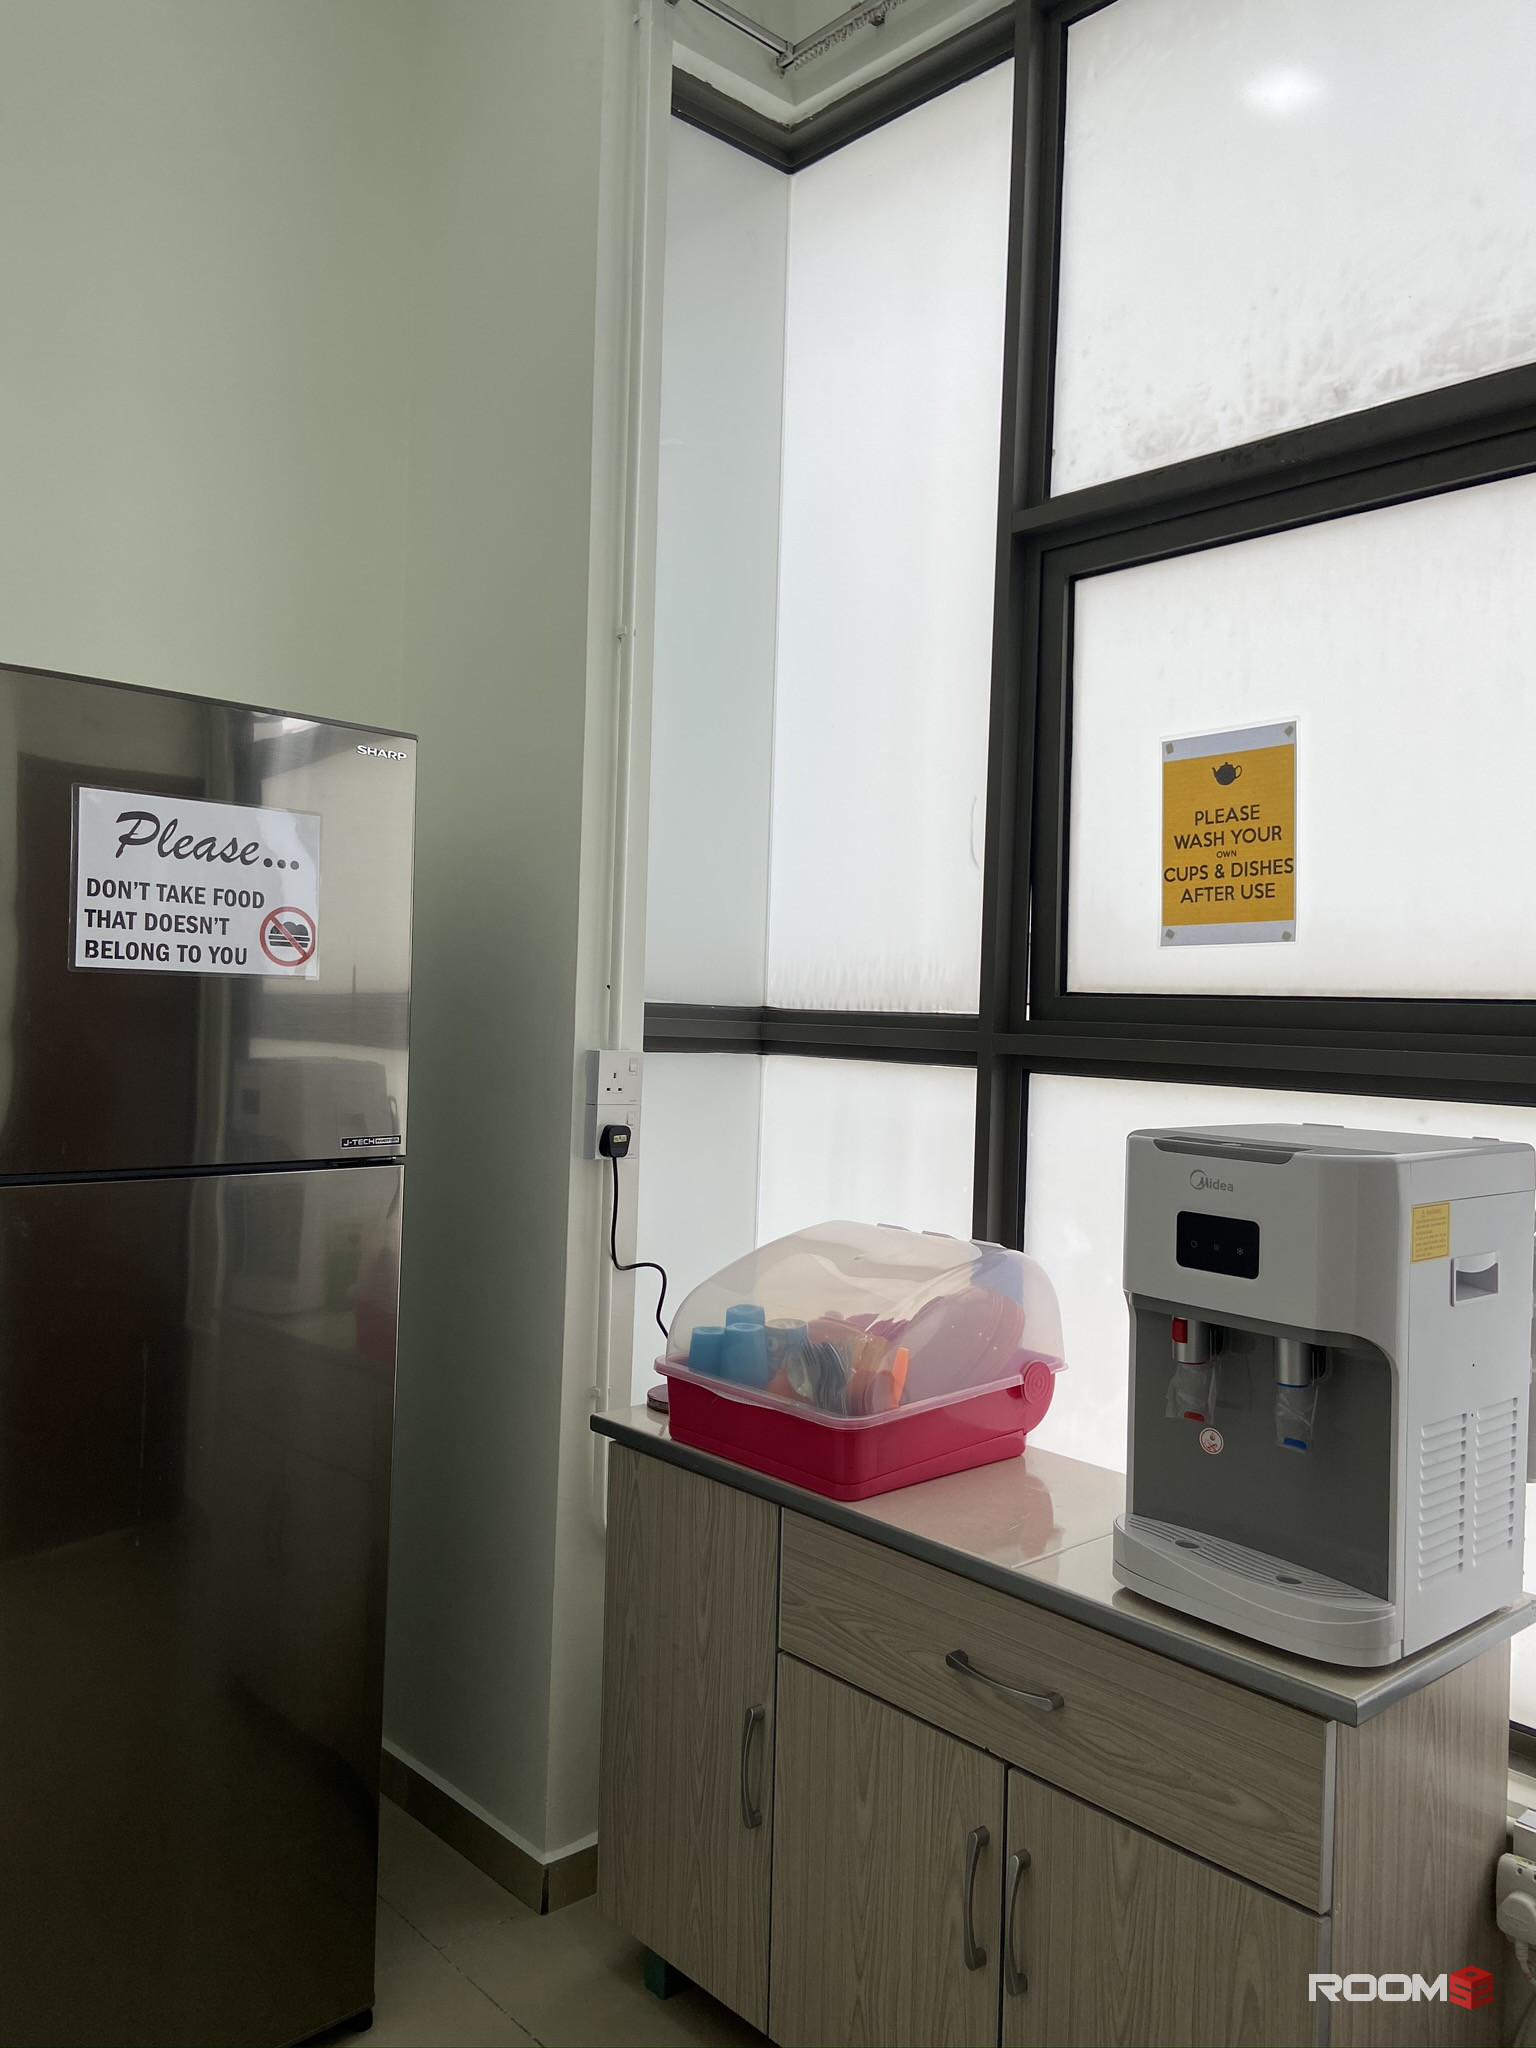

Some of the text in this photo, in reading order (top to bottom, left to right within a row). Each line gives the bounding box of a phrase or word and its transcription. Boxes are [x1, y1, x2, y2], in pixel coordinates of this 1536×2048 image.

[357, 745, 407, 760] SHARP
[1195, 804, 1260, 826] PLEASE
[1174, 826, 1282, 850] WASH YOUR
[1216, 850, 1237, 858] OWN
[1164, 857, 1294, 882] CUPS & DISHES
[86, 877, 265, 909] DON'T TAKE FOOD
[1180, 883, 1275, 903] AFTER USE
[84, 908, 230, 936] THAT DOESN'T
[85, 939, 247, 966] BELONG TO YOU
[343, 1138, 375, 1146] J-TECH
[1190, 1169, 1234, 1192] Midea
